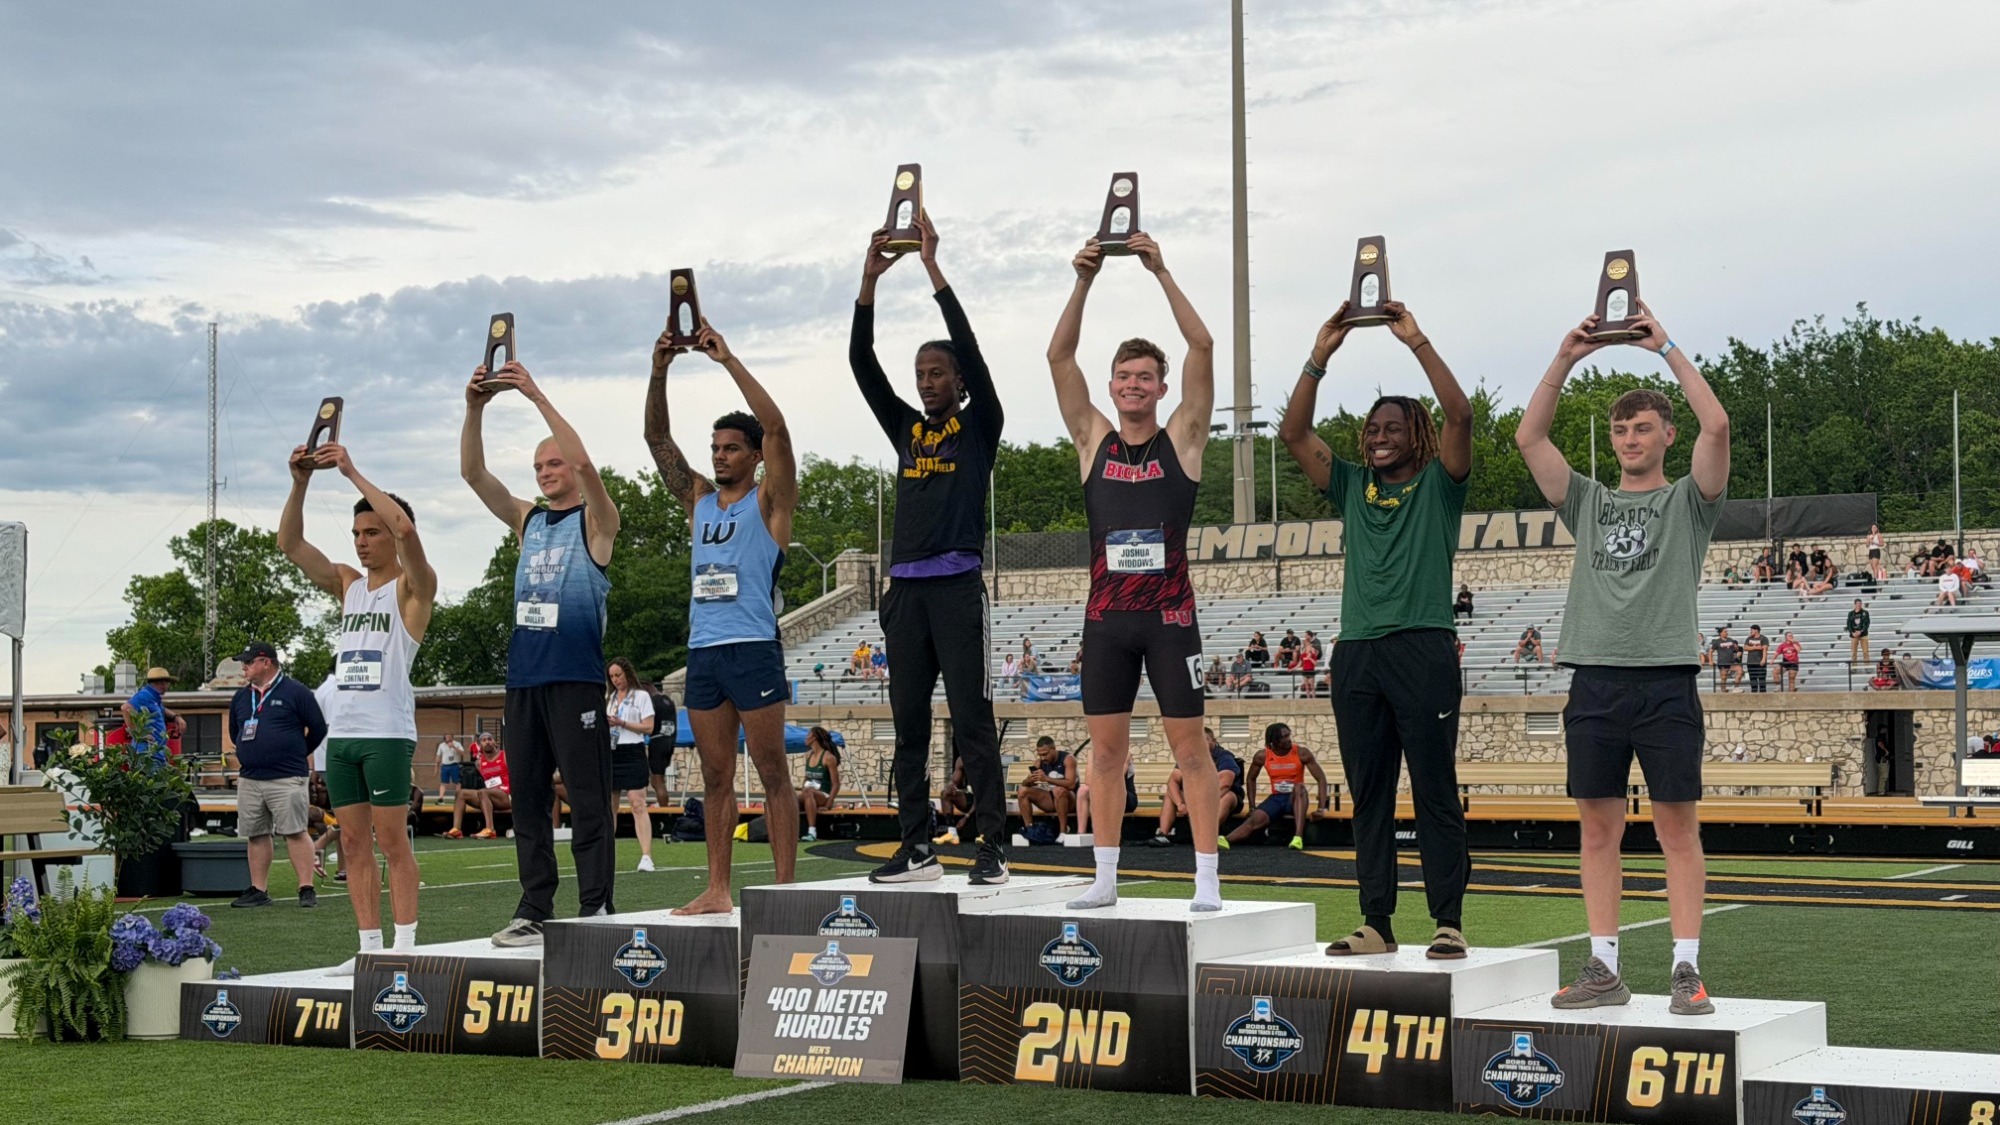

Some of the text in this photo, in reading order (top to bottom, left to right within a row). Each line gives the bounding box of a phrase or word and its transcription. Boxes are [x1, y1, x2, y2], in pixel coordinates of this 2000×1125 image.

[1102, 459, 1165, 482] BIOLA
[701, 521, 737, 546] W
[1186, 521, 1344, 560] EMPOR
[1117, 558, 1154, 568] WIDDOWS
[1121, 548, 1150, 558] JOSHUA
[1161, 609, 1193, 628] BU
[1193, 657, 1203, 686] 6
[1395, 831, 1417, 839] GILL
[1946, 840, 1974, 849] GILL
[820, 927, 878, 937] CHAMPIONSHIPS
[614, 959, 666, 968] CHAMPIONSHIPS
[1041, 955, 1101, 966] CHAMPIONSHIPS
[375, 1003, 427, 1013] CHAMPIONSHIPS
[463, 980, 534, 1034] 5TH
[767, 987, 888, 1015] 400 METER
[294, 998, 342, 1038] 7TH
[594, 992, 684, 1060] 3RD
[774, 1013, 872, 1041] HURDLES
[808, 1045, 831, 1055] MEN'S
[1014, 1001, 1131, 1082] 2ND
[1225, 1035, 1301, 1049] CHAMPIONSHIPS
[1346, 1008, 1446, 1074] 4TH
[773, 1054, 864, 1077] CHAMPION
[1484, 1070, 1562, 1084] CHAMPIONSHIPS
[1626, 1046, 1725, 1108] 6TH
[1968, 1100, 2000, 1125] 8
